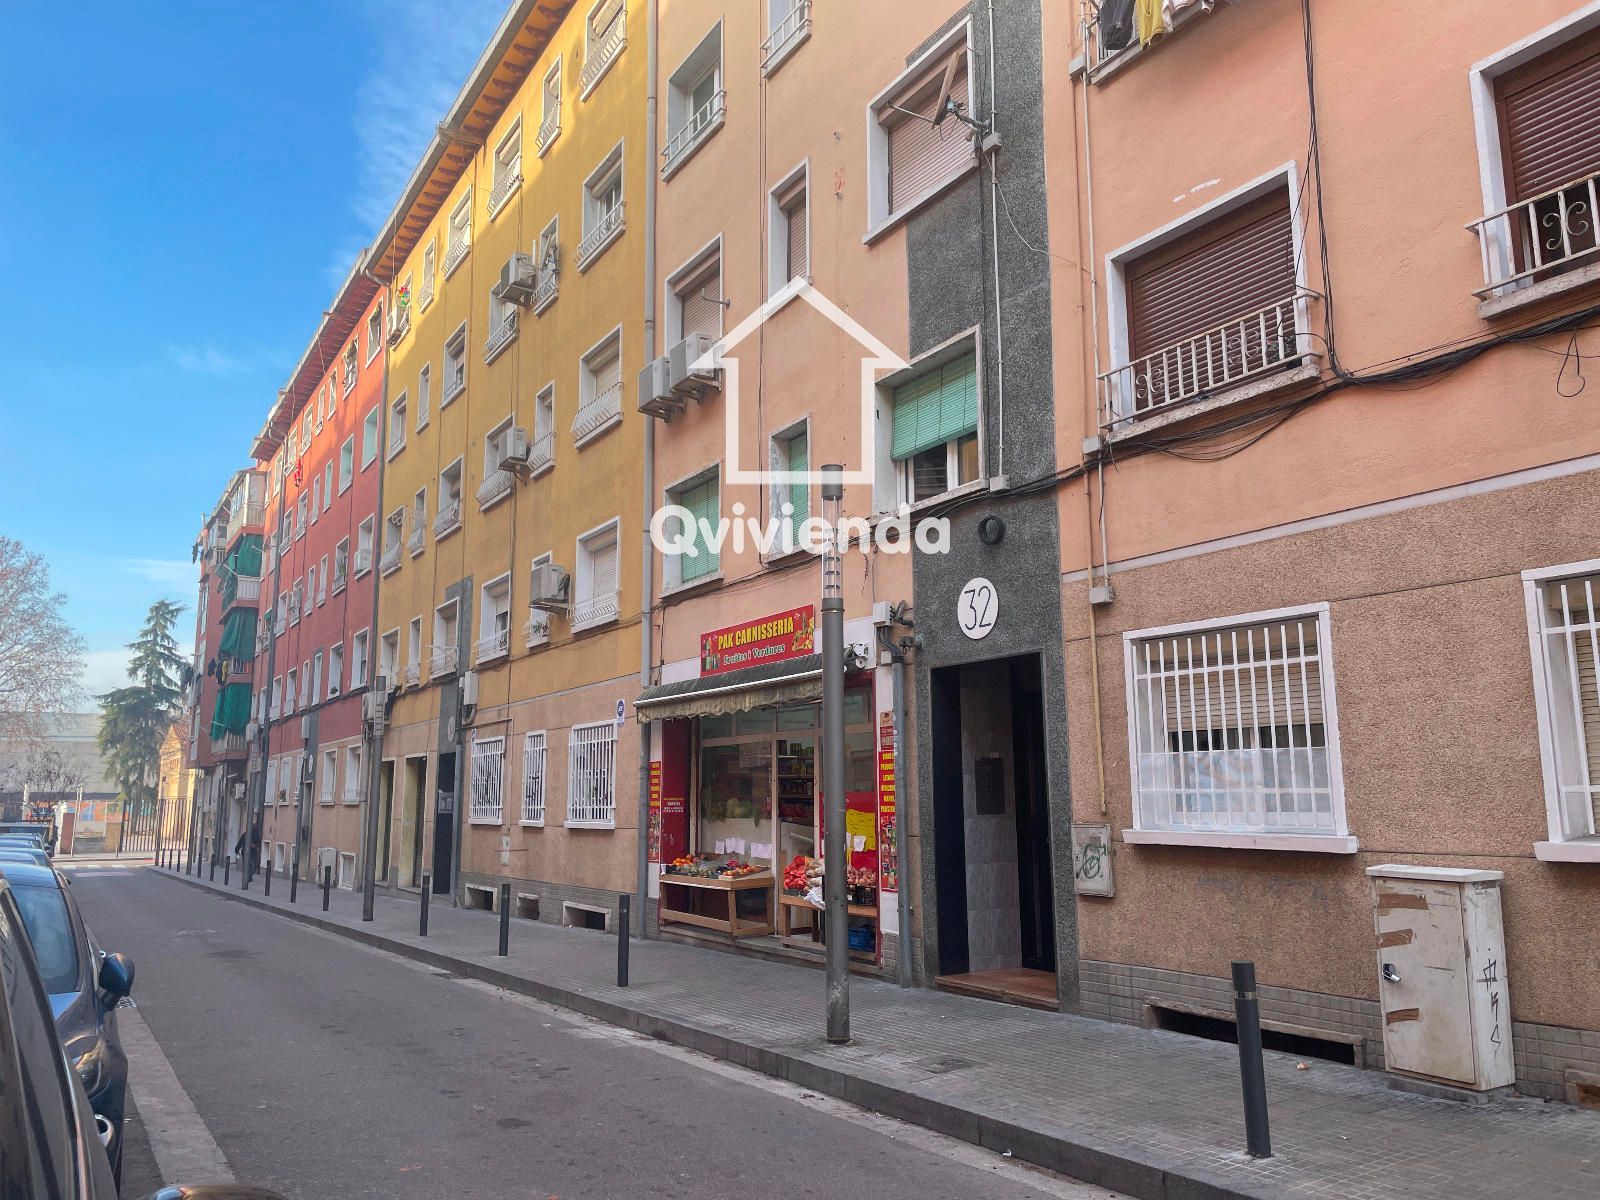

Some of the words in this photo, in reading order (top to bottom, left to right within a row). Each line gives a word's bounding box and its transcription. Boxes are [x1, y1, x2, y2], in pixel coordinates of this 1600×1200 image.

[964, 586, 991, 630] 32
[718, 633, 734, 650] PAK
[735, 616, 794, 646] CARNISSERIA
[752, 643, 785, 658] Verdures
